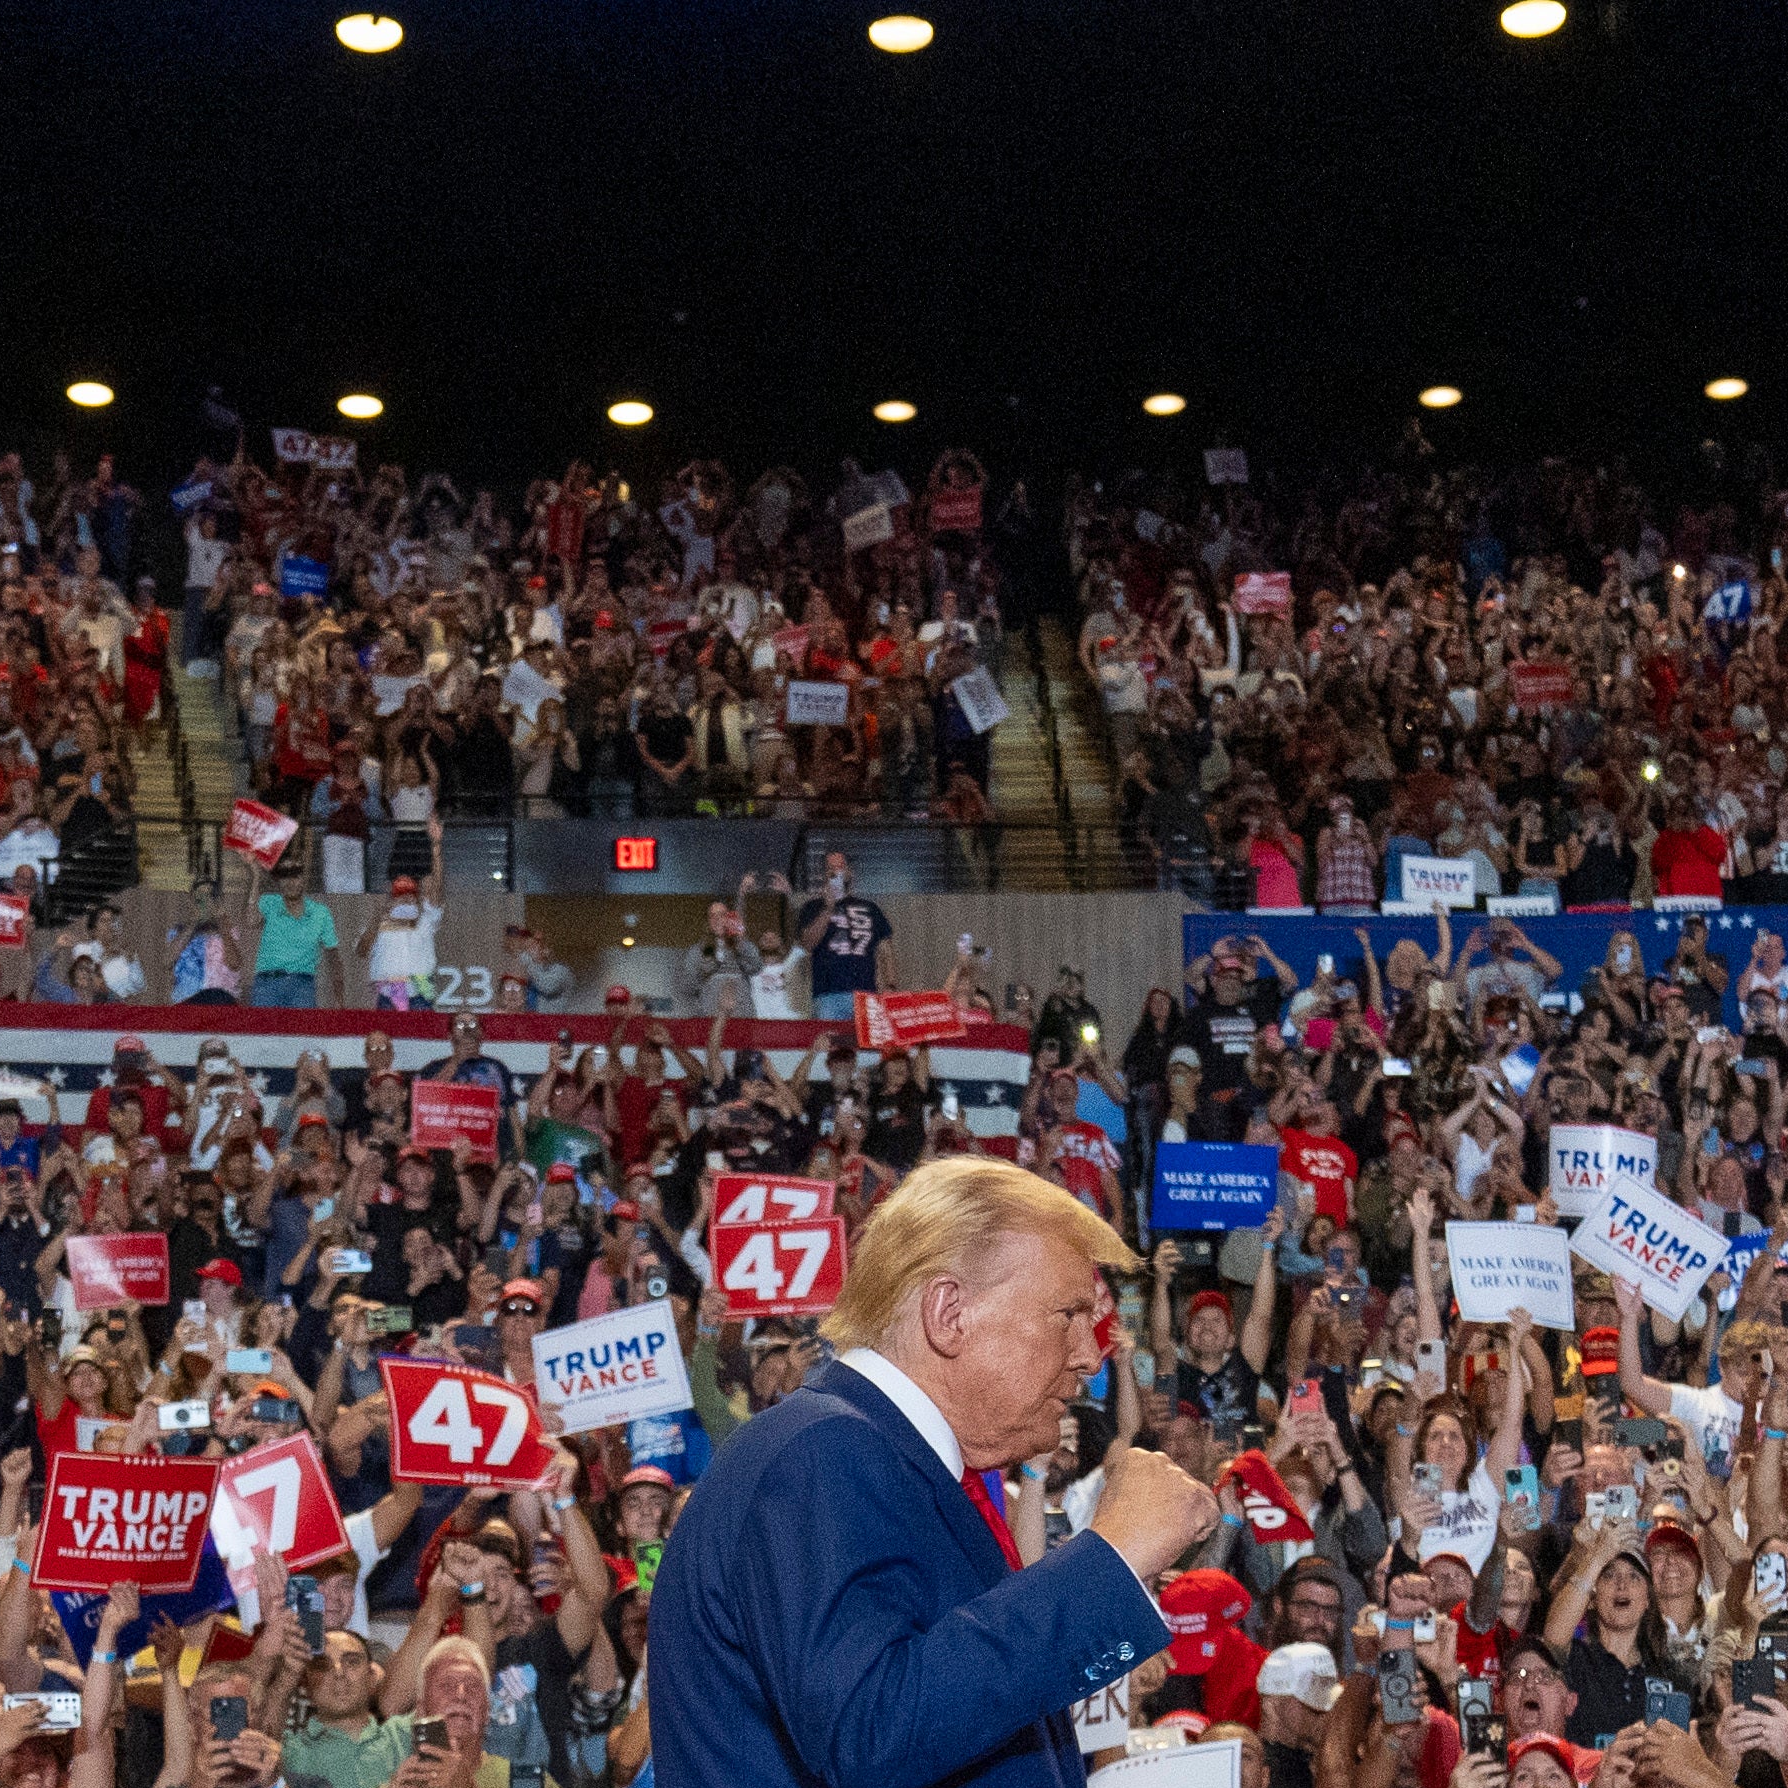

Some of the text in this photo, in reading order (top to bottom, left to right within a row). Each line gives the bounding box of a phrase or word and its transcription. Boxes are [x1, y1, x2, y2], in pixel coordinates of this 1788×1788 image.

[1703, 586, 1743, 618] 47
[616, 839, 656, 869] EXIT
[437, 966, 493, 1006] 23
[1557, 1149, 1651, 1176] TRUMP
[1163, 1172, 1269, 1187] MAKE AMERICA
[1169, 1188, 1261, 1202] GREAT AGAIN
[1609, 1195, 1709, 1272] TRUMP
[725, 1230, 829, 1300] 47
[1459, 1256, 1565, 1276] MAKE AMERICA
[1608, 1223, 1687, 1282] VANCE
[1470, 1272, 1559, 1292] GREAT AGAIN
[545, 1332, 666, 1383] TRUMP
[559, 1360, 657, 1396] VANCE
[409, 1379, 529, 1465] 47
[58, 1485, 208, 1526] TRUMP
[71, 1521, 187, 1551] VANCE
[58, 1547, 84, 1559] MAKE
[86, 1548, 132, 1562] AMERICA
